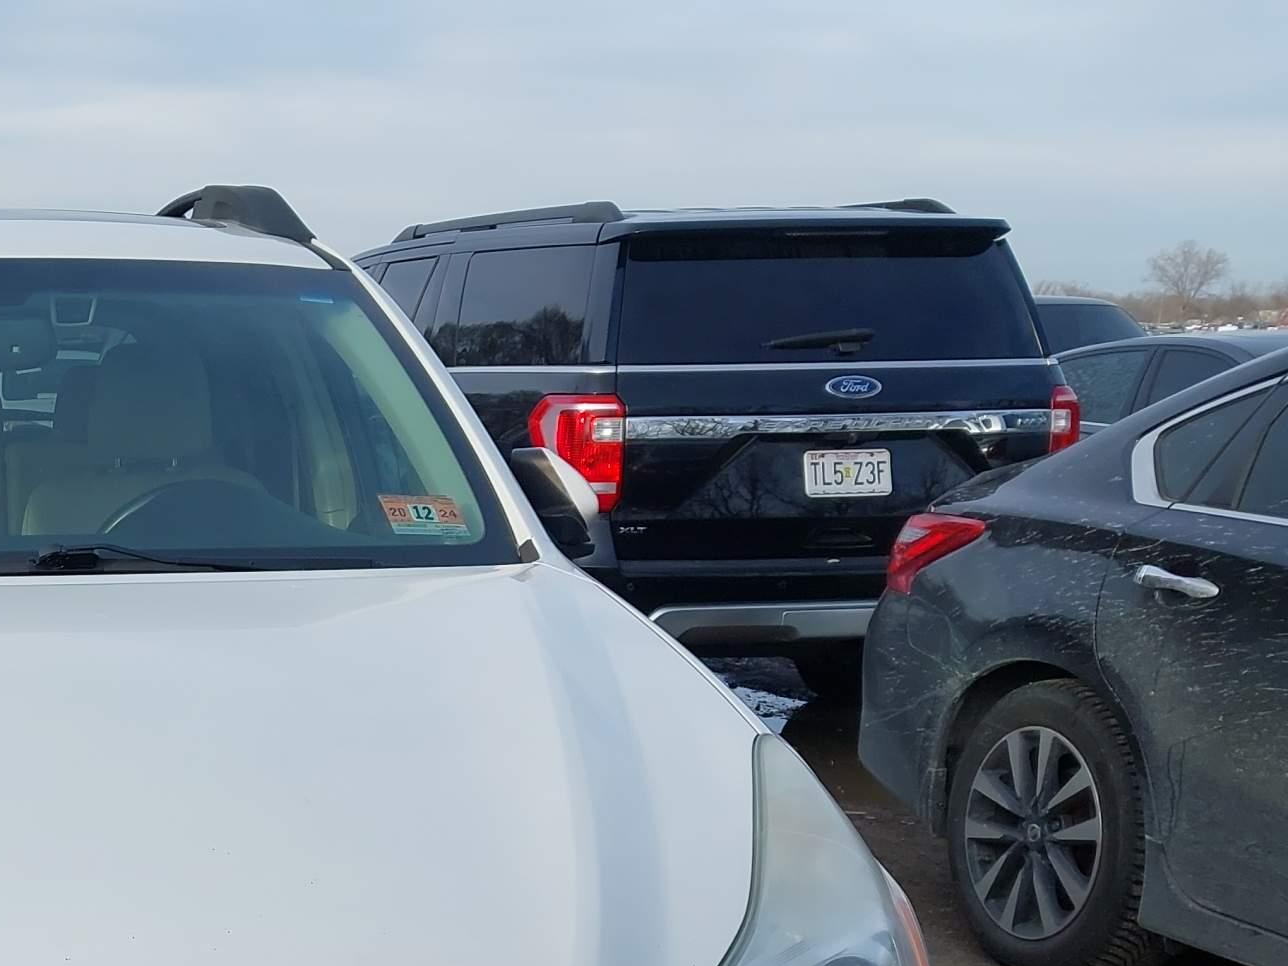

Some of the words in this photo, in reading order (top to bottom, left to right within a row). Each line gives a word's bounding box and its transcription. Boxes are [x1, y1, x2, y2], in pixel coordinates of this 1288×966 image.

[840, 379, 869, 392] Ford
[810, 461, 844, 486] TL5
[854, 460, 887, 486] Z3F
[389, 507, 407, 518] 20
[412, 505, 434, 521] 12
[438, 509, 457, 519] 24
[619, 526, 648, 534] XLT
